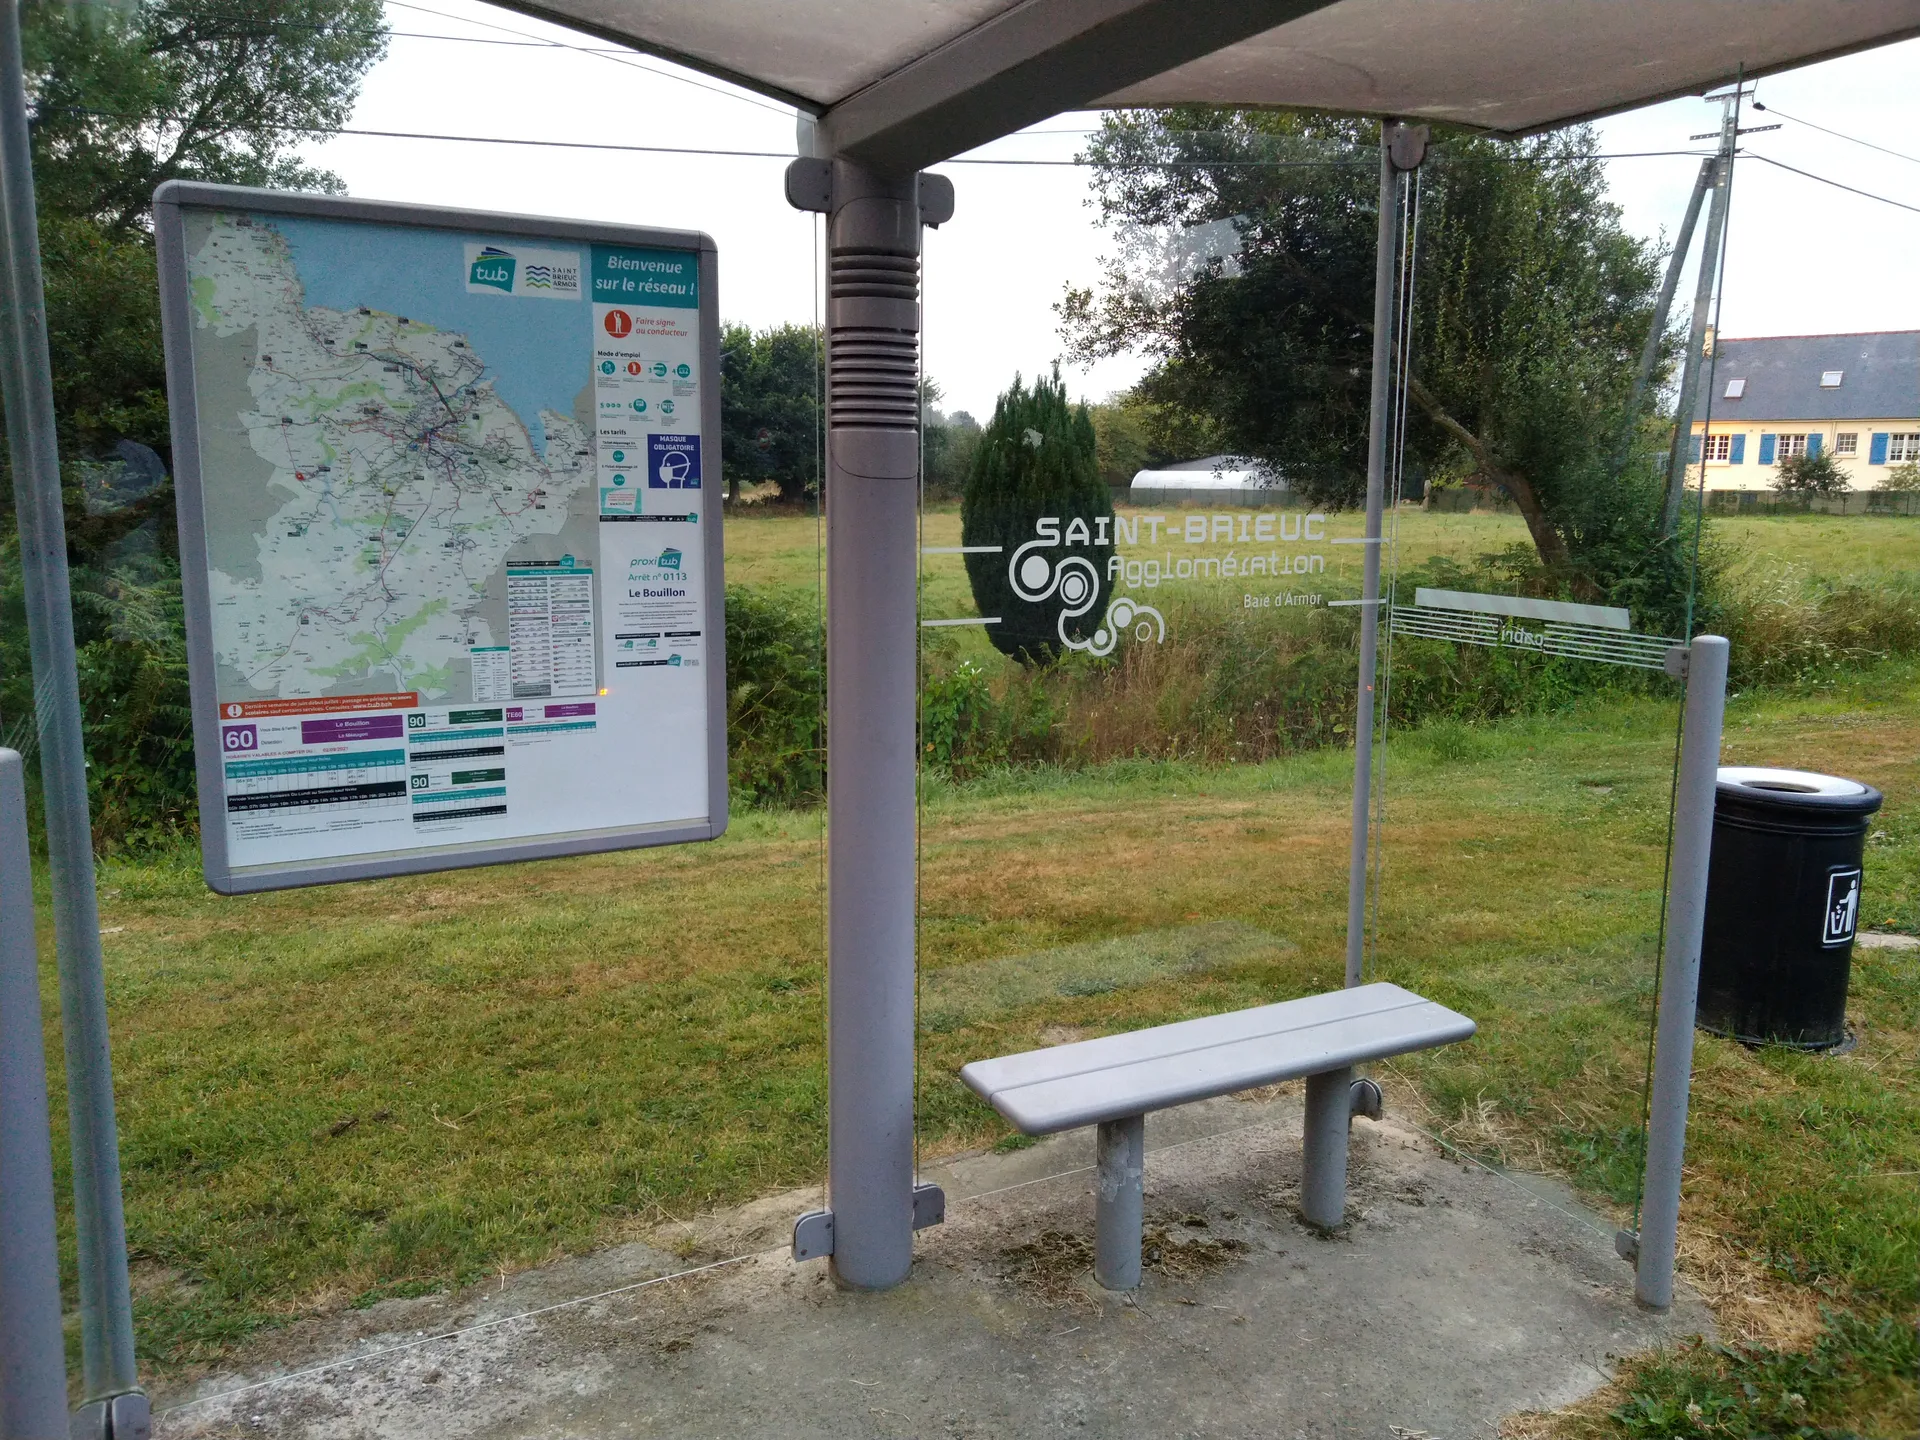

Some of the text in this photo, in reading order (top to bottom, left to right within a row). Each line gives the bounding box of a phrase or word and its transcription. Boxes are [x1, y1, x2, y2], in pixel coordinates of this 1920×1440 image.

[607, 255, 683, 274] Bienvenue
[476, 266, 508, 281] tub
[595, 277, 695, 295] sur le réseau !
[635, 317, 676, 328] Faire signe
[647, 328, 688, 337] conducteur
[1036, 514, 1325, 546] SAINT-BRIEUC
[630, 556, 678, 568] proxi tub
[1107, 549, 1325, 589] Agglomération
[628, 573, 687, 581] Arrêt n° 0113
[629, 588, 686, 597] Le Bouillon
[1244, 592, 1322, 608] Baie d'Armor
[409, 716, 424, 727] 90
[226, 731, 254, 749] 60
[412, 777, 427, 788] 90
